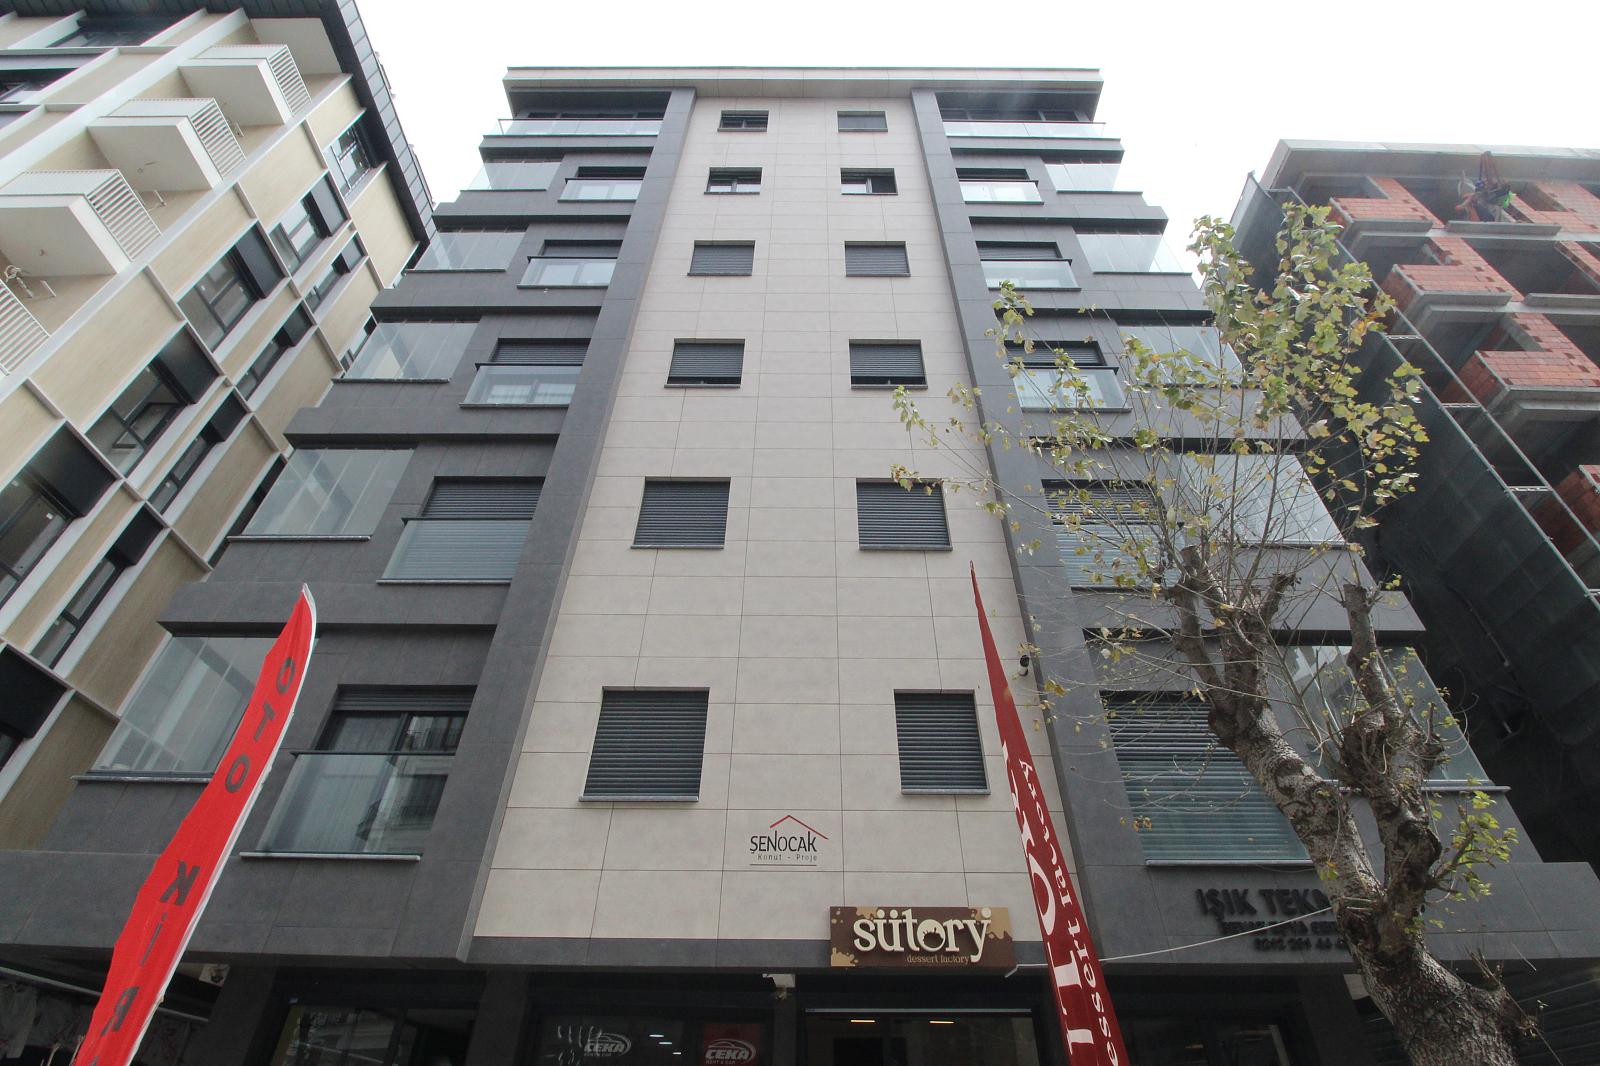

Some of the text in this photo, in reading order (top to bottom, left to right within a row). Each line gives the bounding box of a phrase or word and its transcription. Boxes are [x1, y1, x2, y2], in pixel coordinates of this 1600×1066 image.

[750, 830, 817, 854] ŞENOCAK
[853, 908, 991, 962] sütory
[906, 954, 970, 965] dessert factory
[1067, 918, 1118, 1066] essert
